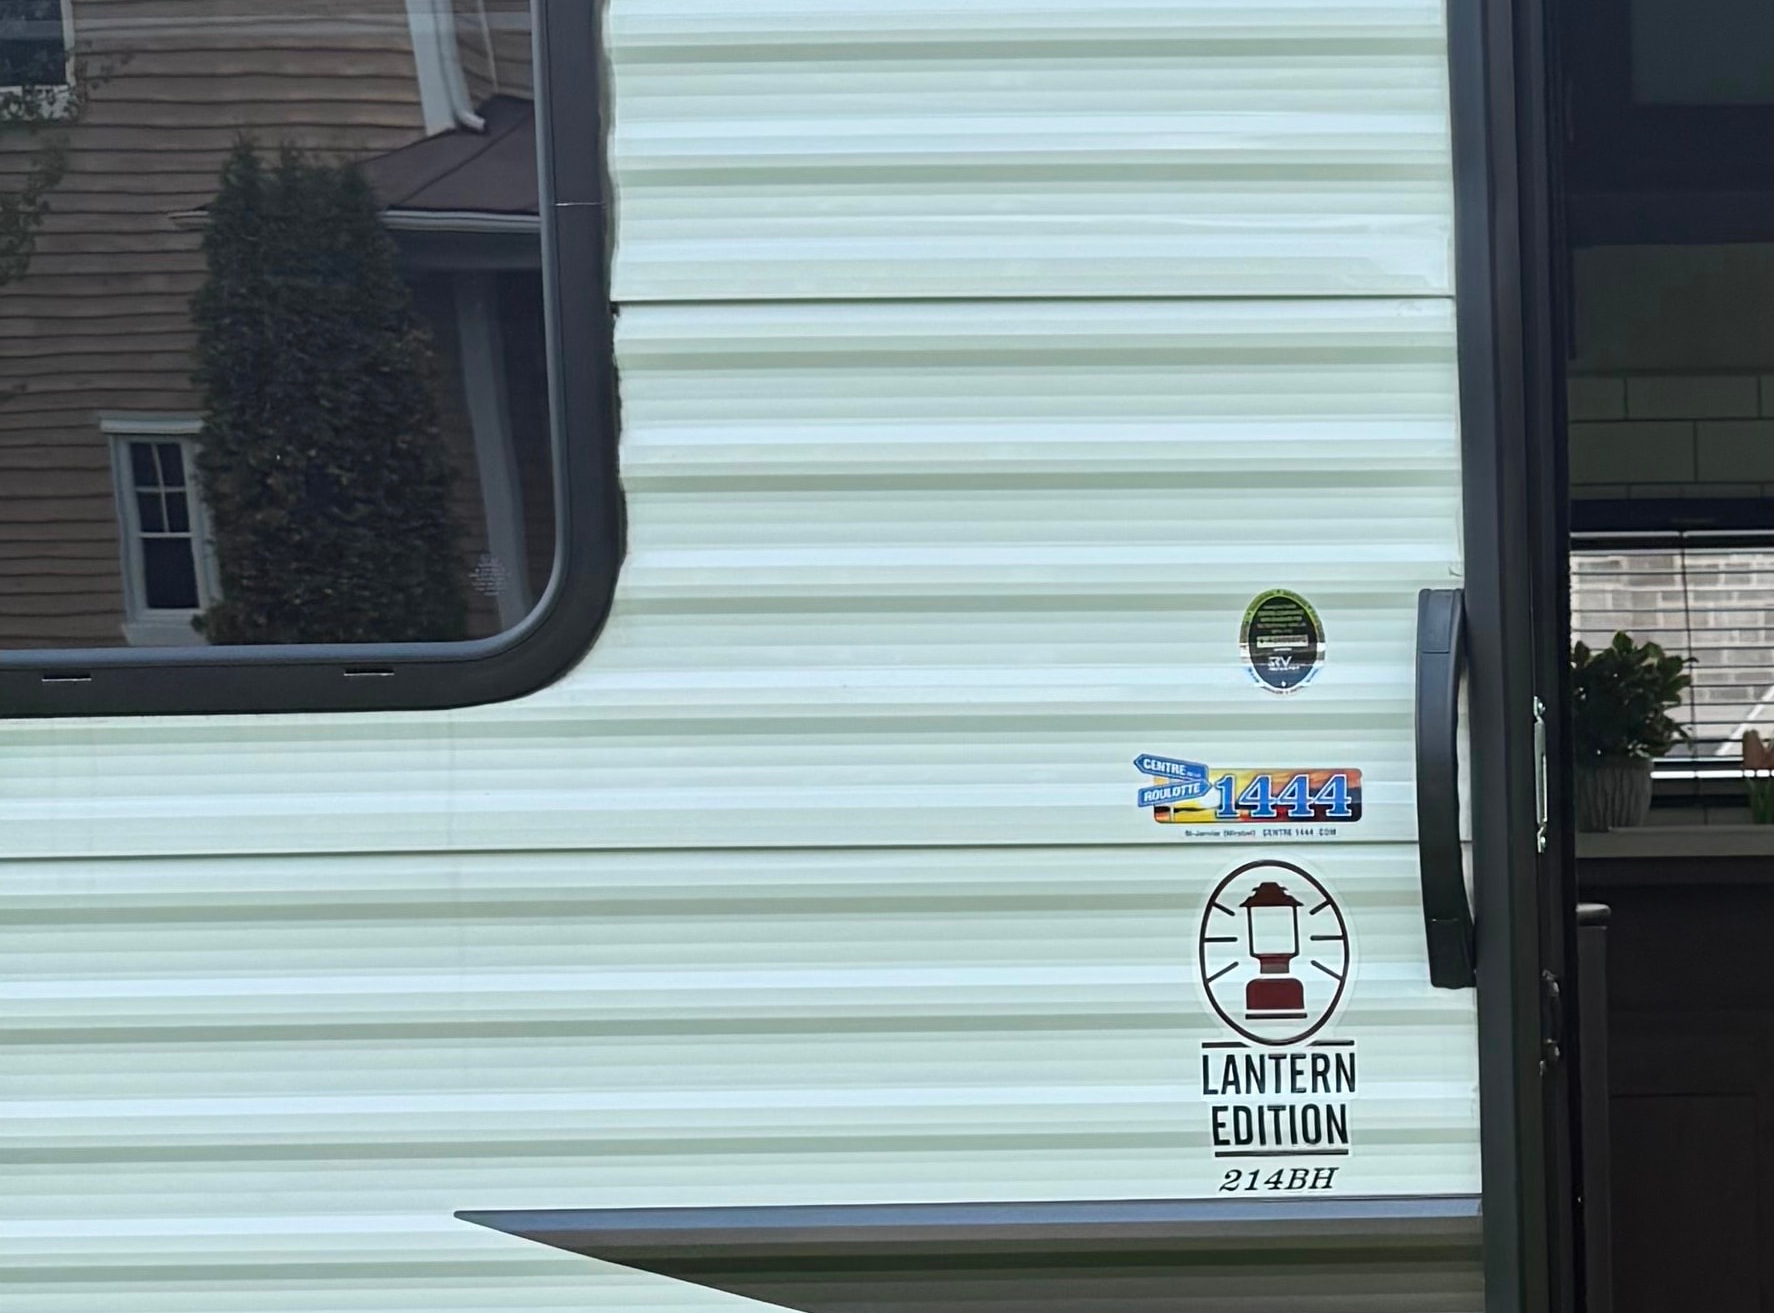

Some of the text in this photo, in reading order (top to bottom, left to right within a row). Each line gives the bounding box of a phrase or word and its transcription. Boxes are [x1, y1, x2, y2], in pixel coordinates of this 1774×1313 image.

[1143, 758, 1187, 776] CENTRE
[1143, 782, 1201, 802] ROULOTTE
[1216, 774, 1353, 819] 1444
[1202, 1052, 1356, 1095] LANTERN
[1211, 1103, 1349, 1146] EDITION
[1218, 1167, 1340, 1192] 214BH
